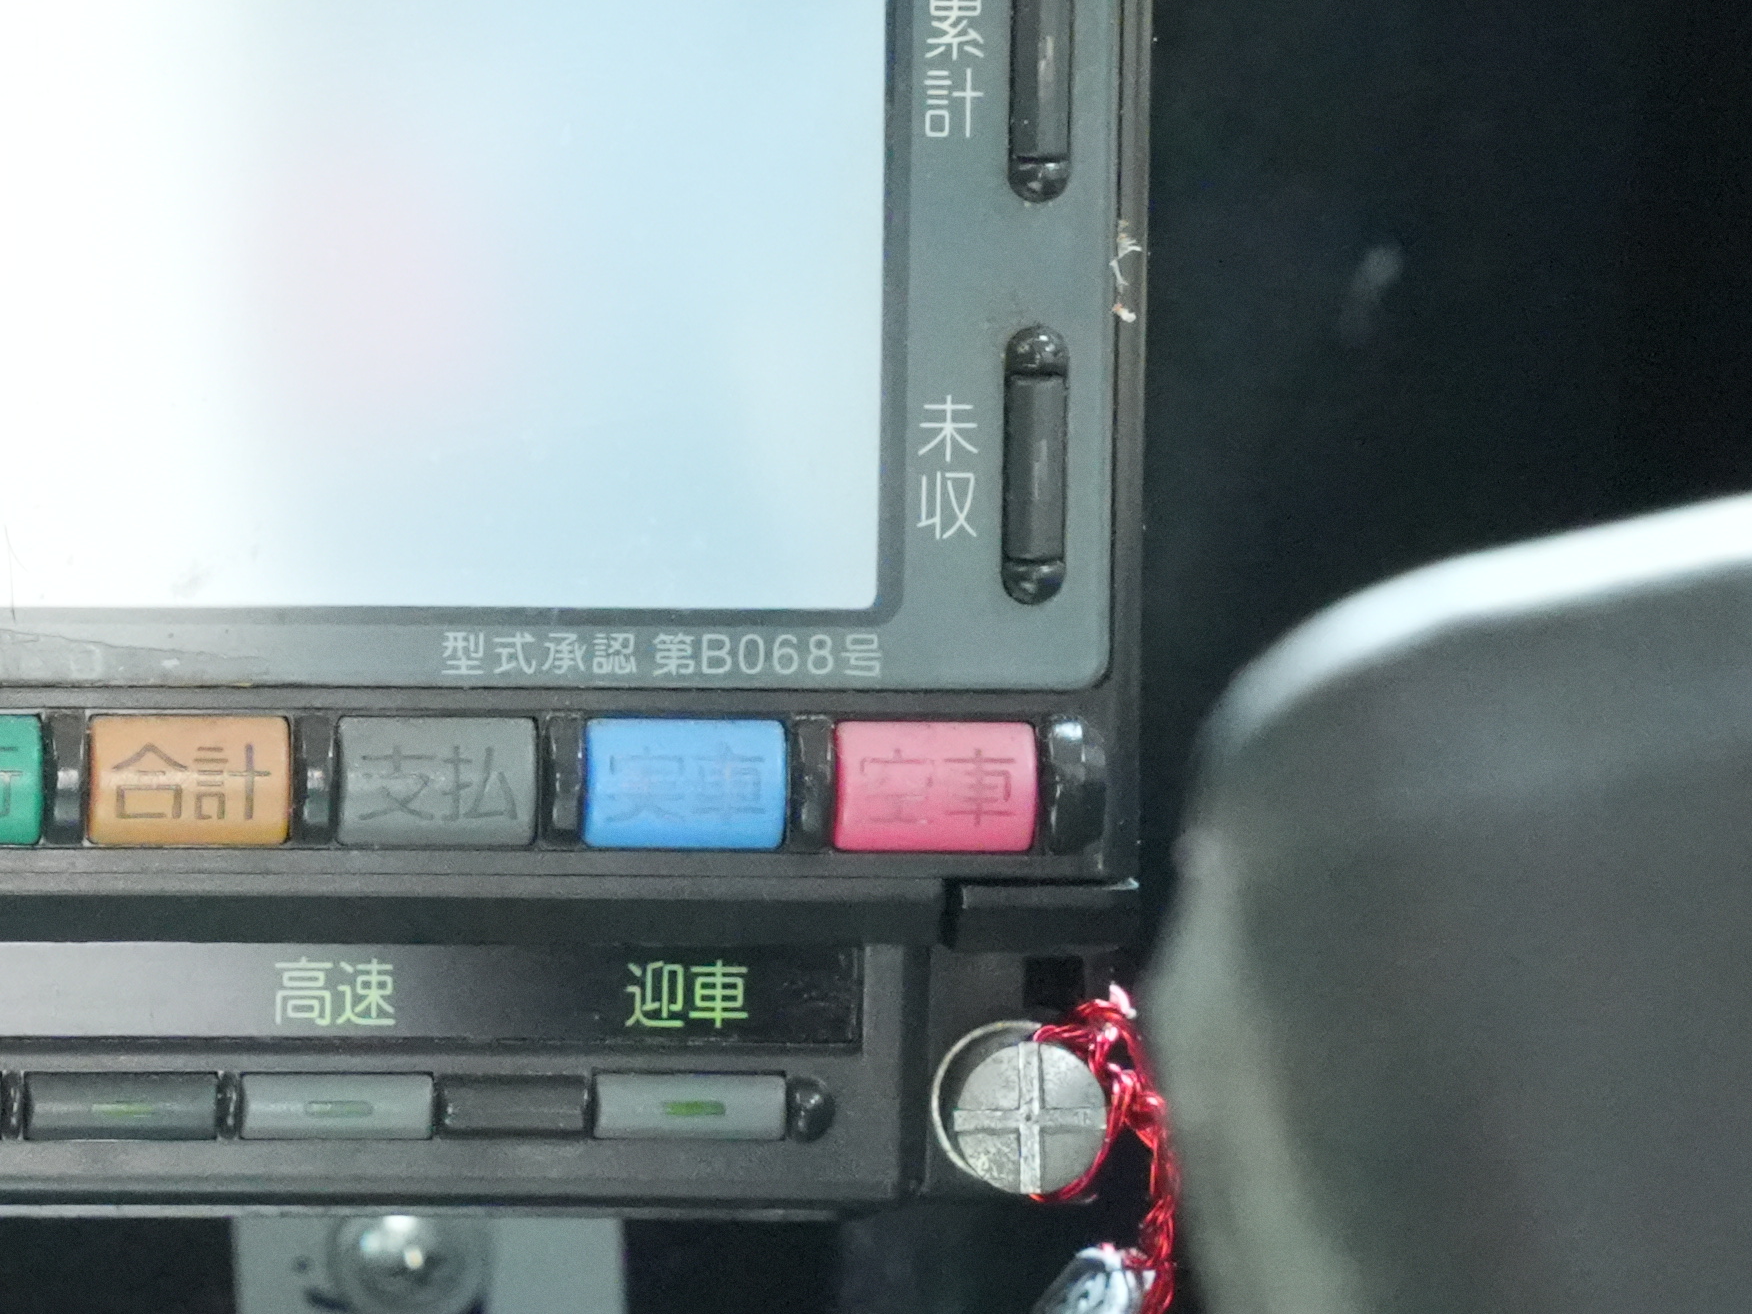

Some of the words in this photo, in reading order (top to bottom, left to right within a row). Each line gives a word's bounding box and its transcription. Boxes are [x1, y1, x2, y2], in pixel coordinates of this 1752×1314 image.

[916, 394, 979, 540] 未収
[440, 631, 638, 677] 型式承認
[651, 632, 884, 678] 第B068号
[110, 742, 272, 821] 合計
[359, 744, 518, 823] 支払
[604, 746, 767, 825] 実車
[860, 747, 1016, 827] 空車
[274, 956, 396, 1027] 高速
[624, 959, 749, 1029] 迎車
